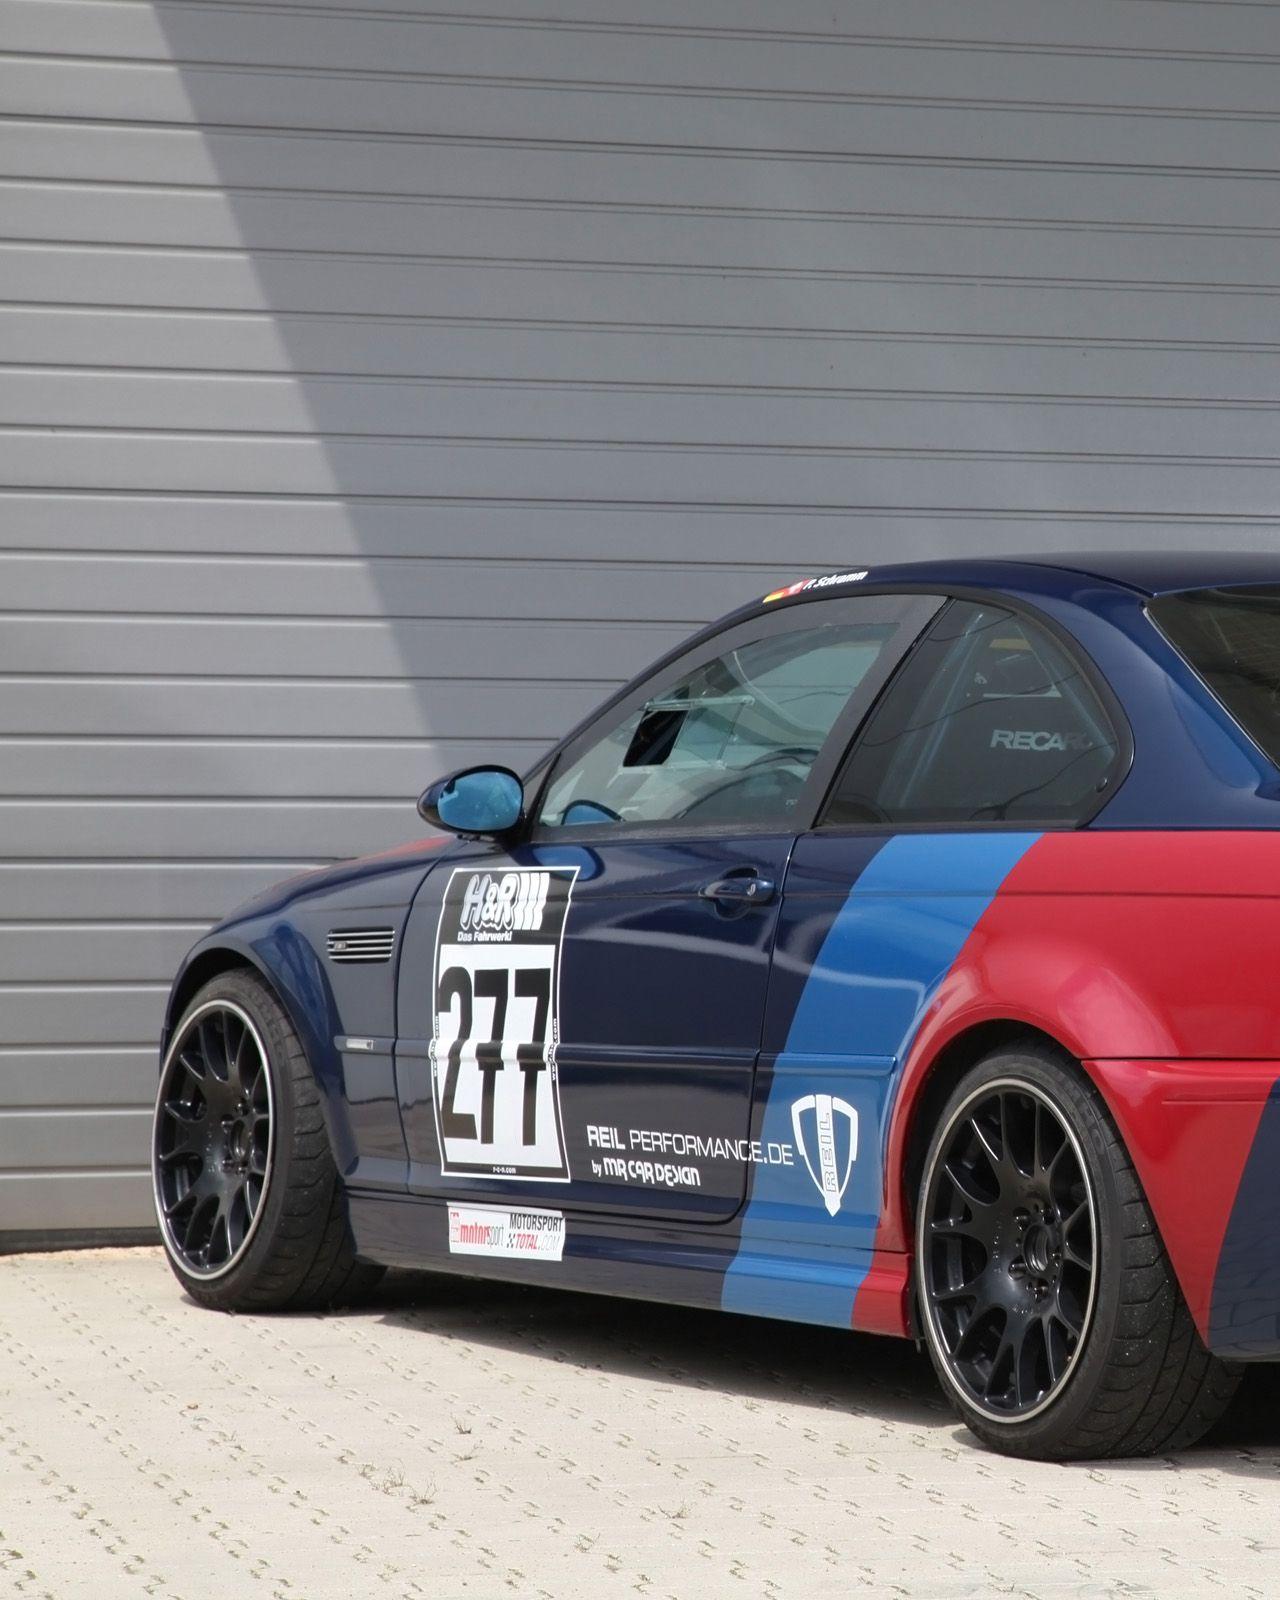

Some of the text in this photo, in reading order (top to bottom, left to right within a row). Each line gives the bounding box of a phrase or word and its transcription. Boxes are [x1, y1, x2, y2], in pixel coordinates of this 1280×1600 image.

[460, 873, 520, 931] H&R
[457, 931, 473, 942] Das
[438, 966, 551, 1146] 277
[586, 1125, 795, 1166] REIL PERFORMANCE.DE
[819, 1113, 837, 1193] REIL
[591, 1160, 602, 1177] by
[603, 1157, 628, 1181] MR
[628, 1162, 655, 1184] CAR
[460, 1222, 505, 1248] motorsport
[509, 1212, 563, 1232] MOTORSPORT
